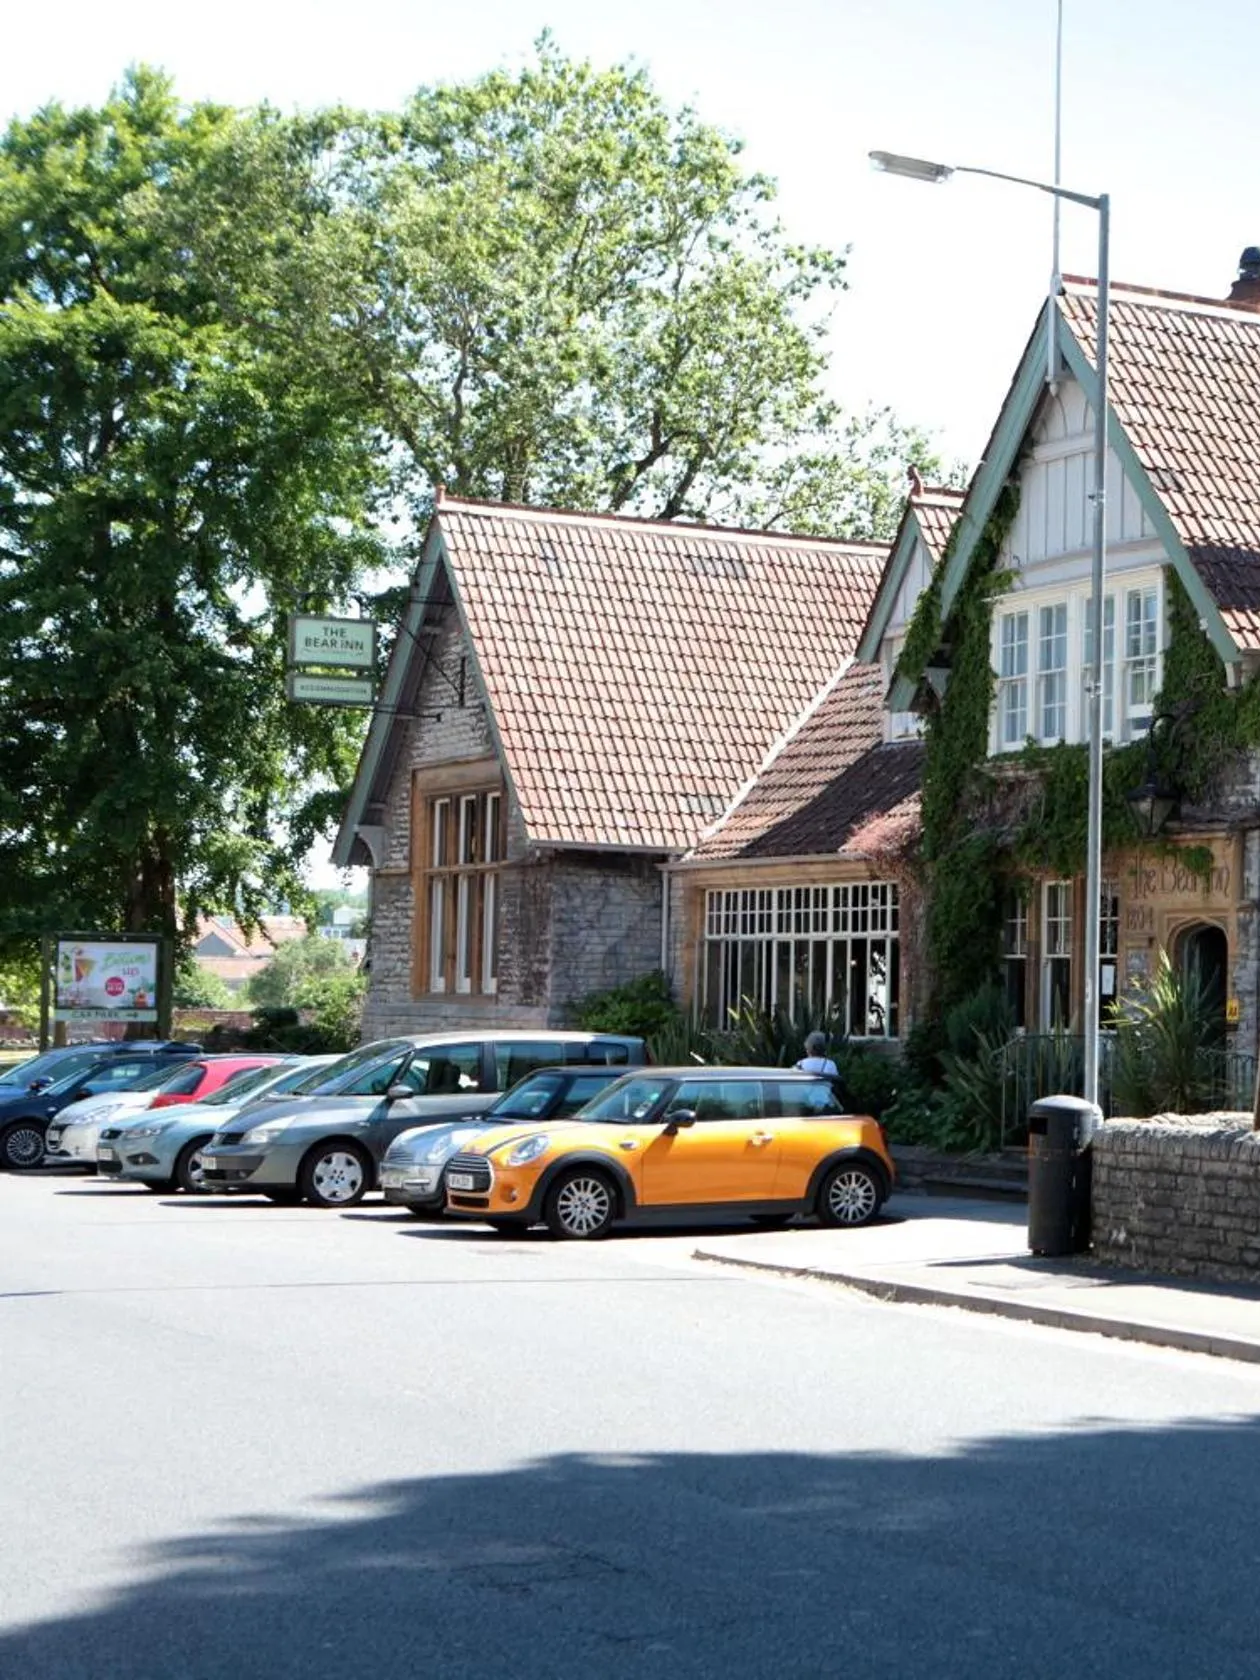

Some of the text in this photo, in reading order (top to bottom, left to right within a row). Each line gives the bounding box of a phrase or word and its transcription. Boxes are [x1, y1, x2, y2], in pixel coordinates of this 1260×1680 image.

[323, 627, 347, 637] THE
[305, 637, 364, 650] BEAR INN
